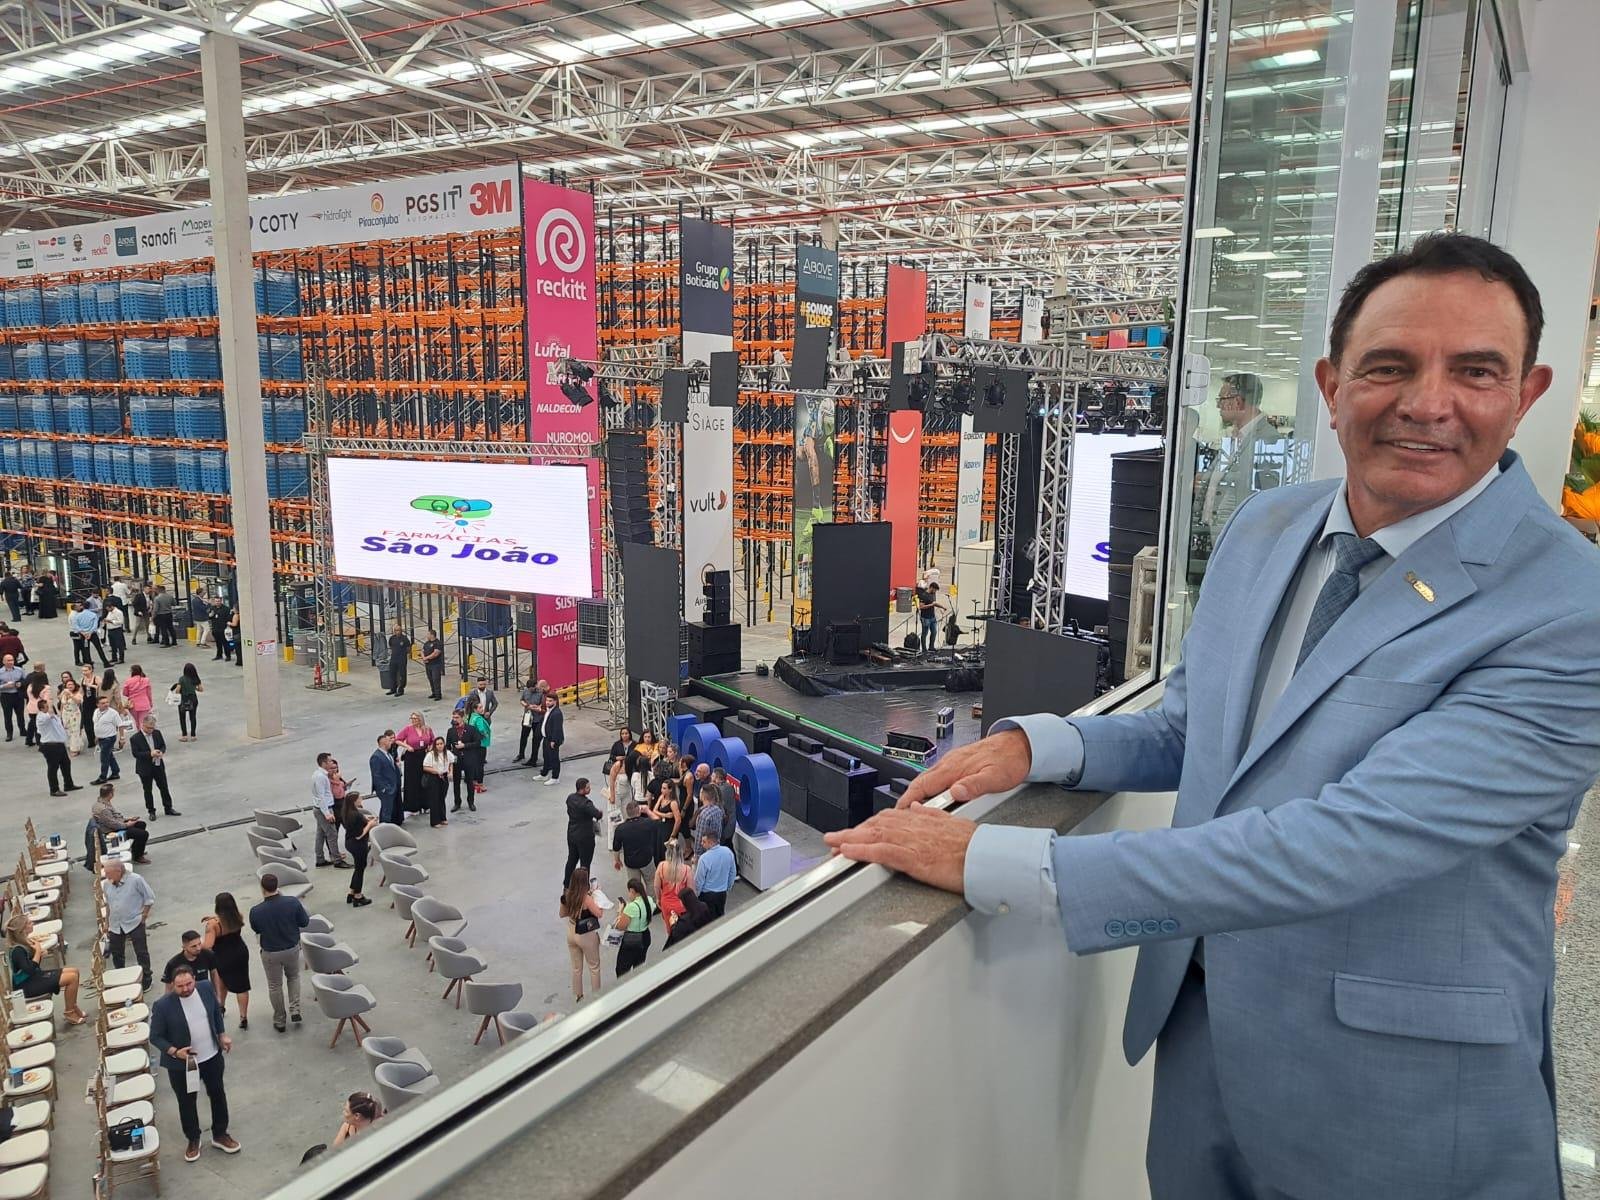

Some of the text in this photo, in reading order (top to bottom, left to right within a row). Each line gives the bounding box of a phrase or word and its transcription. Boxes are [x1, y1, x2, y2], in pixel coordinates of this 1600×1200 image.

[470, 179, 512, 216] 3M
[259, 212, 298, 234] COTY
[141, 227, 177, 249] sanofi
[695, 261, 719, 278] Grupo
[802, 258, 833, 276] ABOVE
[536, 278, 587, 300] reckitt
[685, 273, 719, 290] Boticário
[800, 301, 833, 316] #SOMOS
[805, 313, 832, 327] TODOS
[535, 341, 570, 359] Luftal
[536, 402, 583, 414] NALDECON
[546, 431, 595, 444] NUROMOL
[690, 493, 716, 513] vult
[361, 536, 559, 565] São João
[541, 621, 577, 639] SUSTAGE
